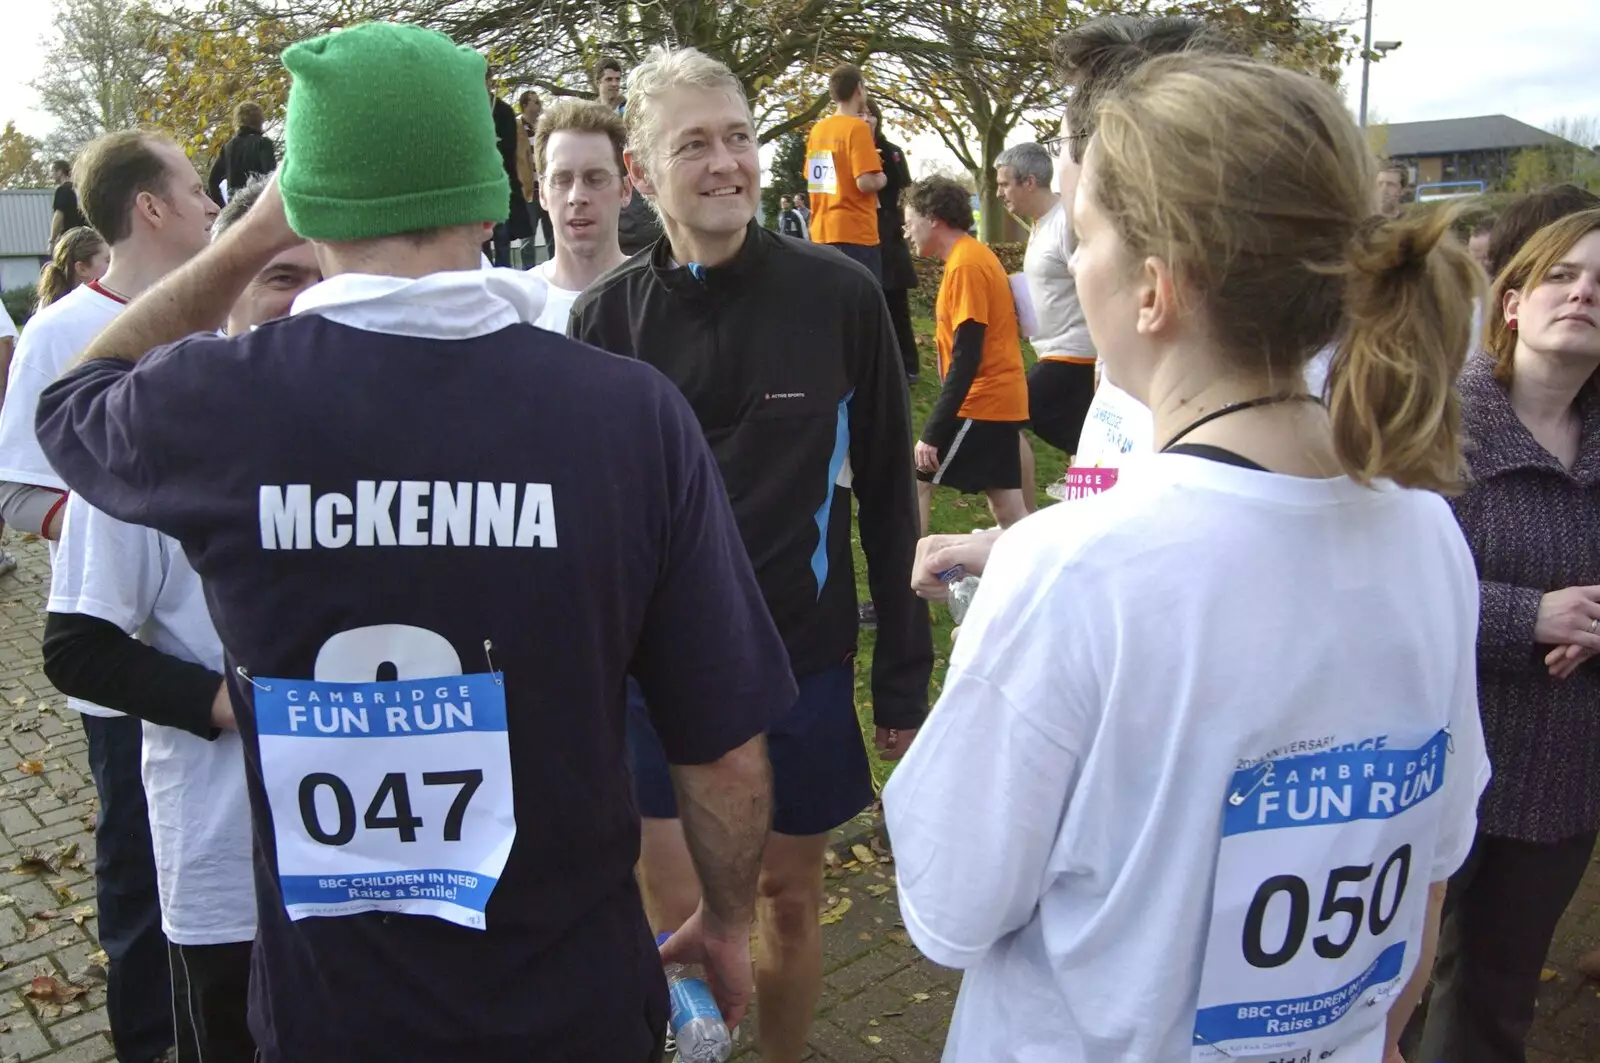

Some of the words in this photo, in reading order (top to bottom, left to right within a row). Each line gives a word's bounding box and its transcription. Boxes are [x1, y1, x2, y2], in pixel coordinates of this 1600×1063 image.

[259, 480, 558, 550] McKENNA
[287, 686, 470, 704] CAMBRIDGE
[288, 705, 370, 733] FUN
[386, 702, 473, 733] RUN
[1263, 744, 1438, 786] CAMBRIDGE
[298, 769, 483, 846] 047
[1257, 784, 1352, 824] FUN
[1368, 763, 1436, 813] RUN
[319, 878, 348, 889] BBC
[352, 873, 425, 888] CHILDREN
[428, 873, 444, 884] IN
[447, 873, 478, 889] NEED
[348, 888, 391, 898] Raise
[396, 888, 405, 897] a
[410, 886, 457, 900] Smile!
[1242, 843, 1412, 968] 050
[1237, 1006, 1271, 1020] BBC
[1276, 988, 1348, 1015] CHILDREN
[1266, 1017, 1313, 1034] Raise
[1317, 1014, 1326, 1026] a
